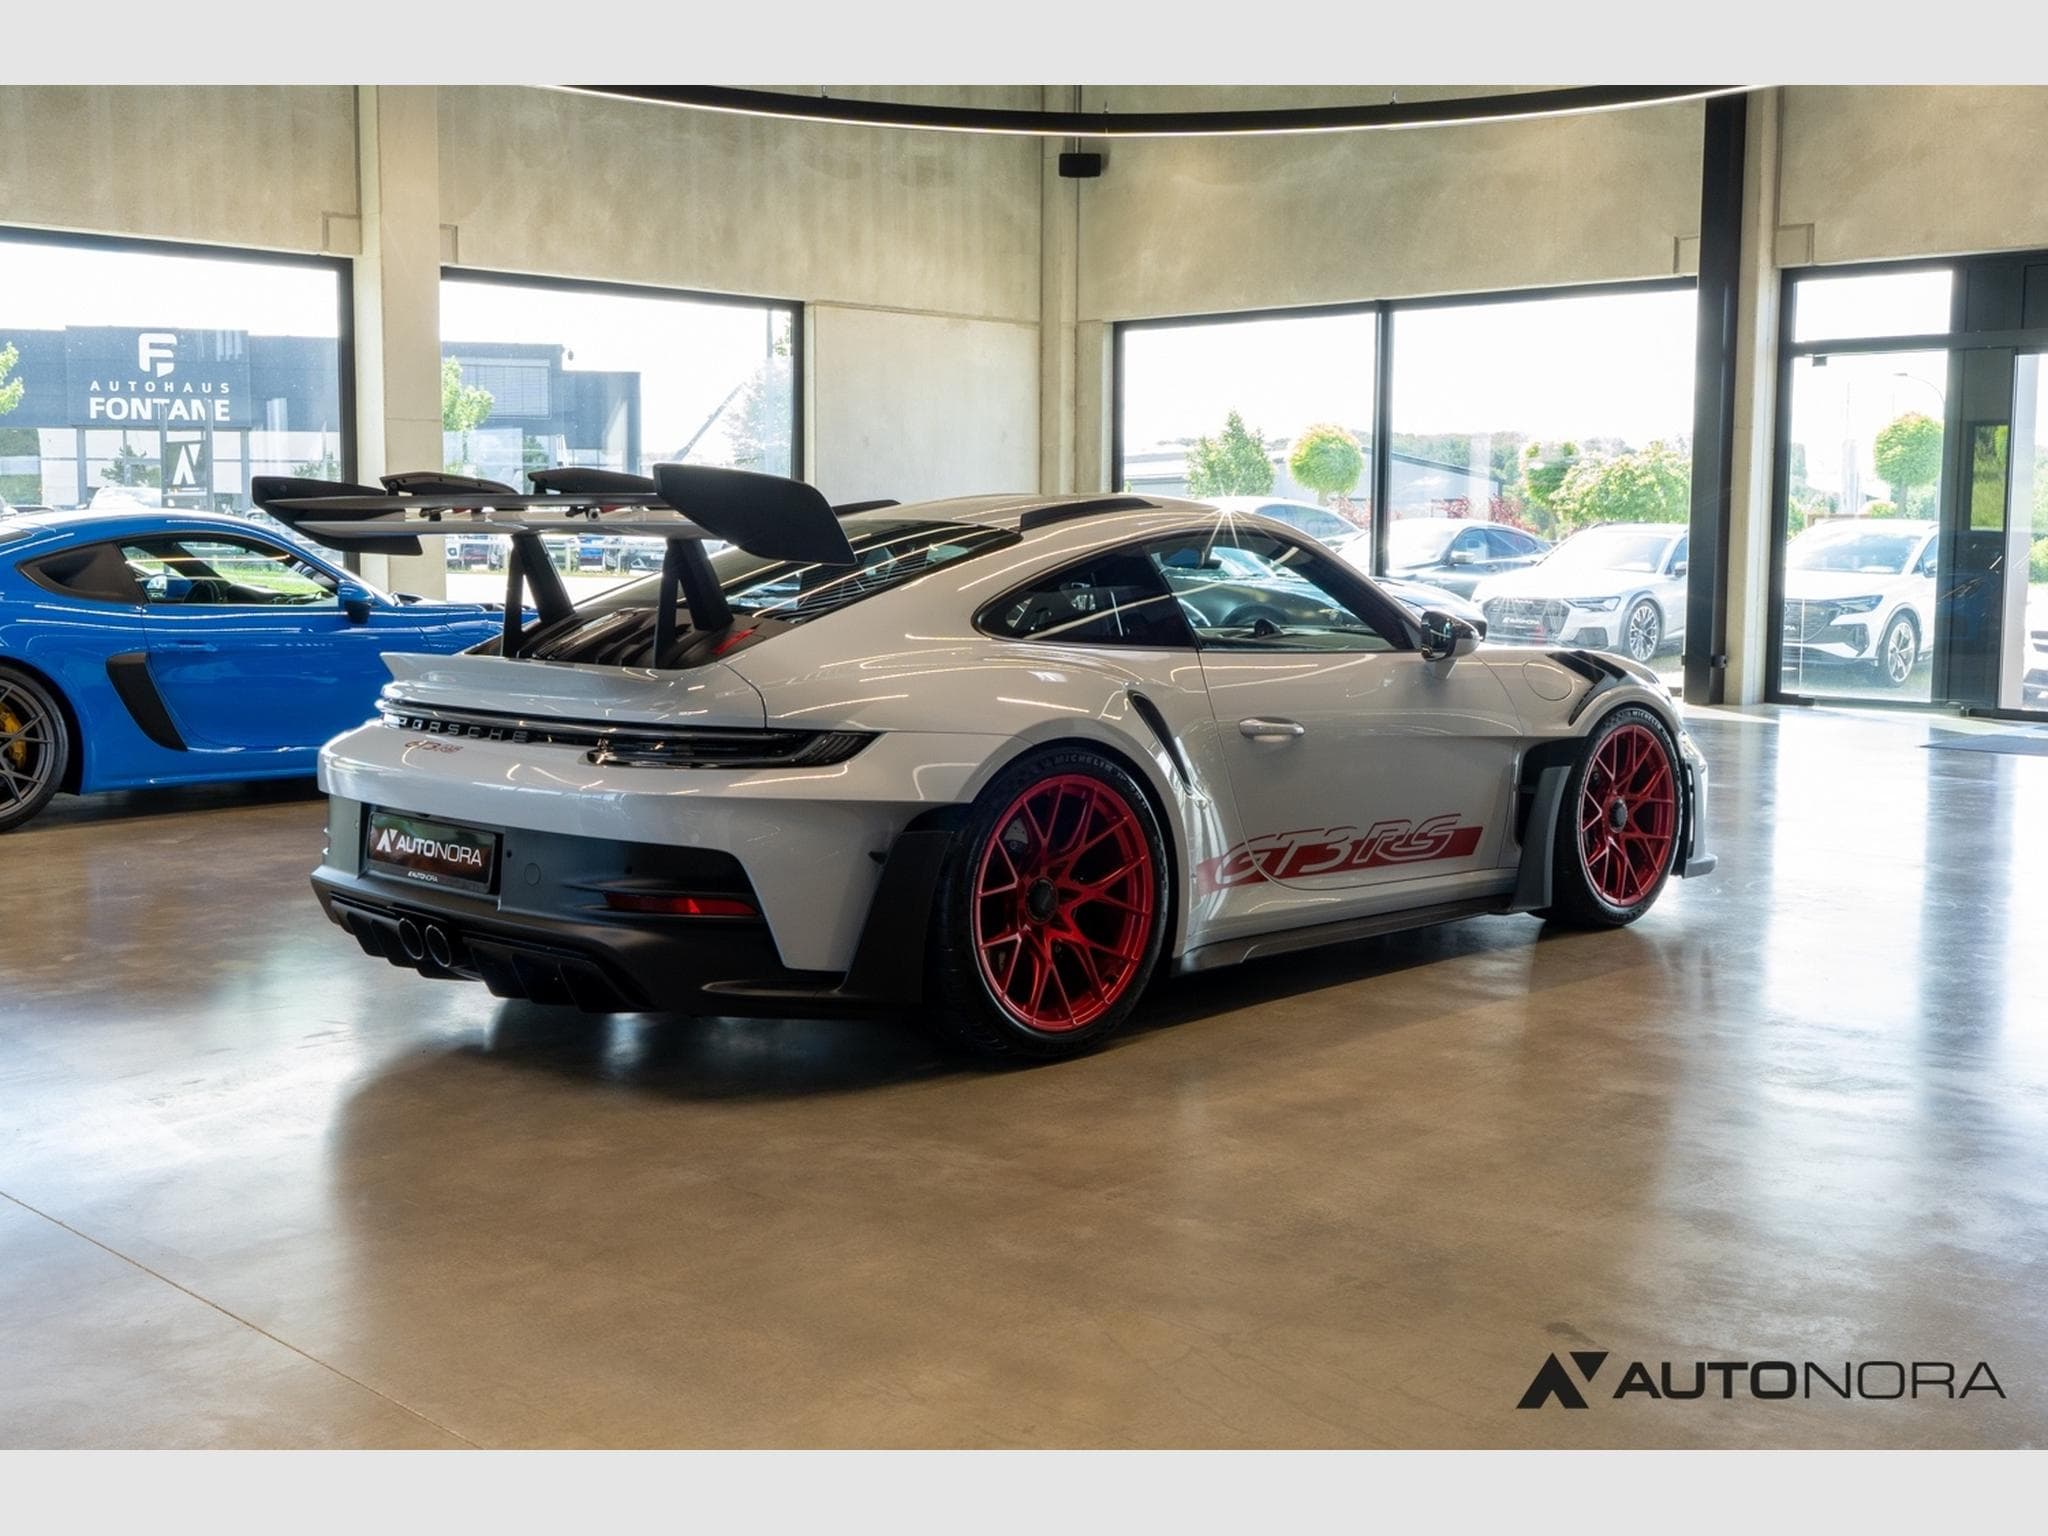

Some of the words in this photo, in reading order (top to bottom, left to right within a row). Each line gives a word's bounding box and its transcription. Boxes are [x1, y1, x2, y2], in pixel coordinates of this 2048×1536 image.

[90, 380, 230, 394] AUTOHAUS
[89, 397, 230, 421] FONTANE
[397, 716, 528, 743] PORSCHE
[1054, 752, 1113, 772] MICHELIN
[395, 834, 482, 867] AUTONORA
